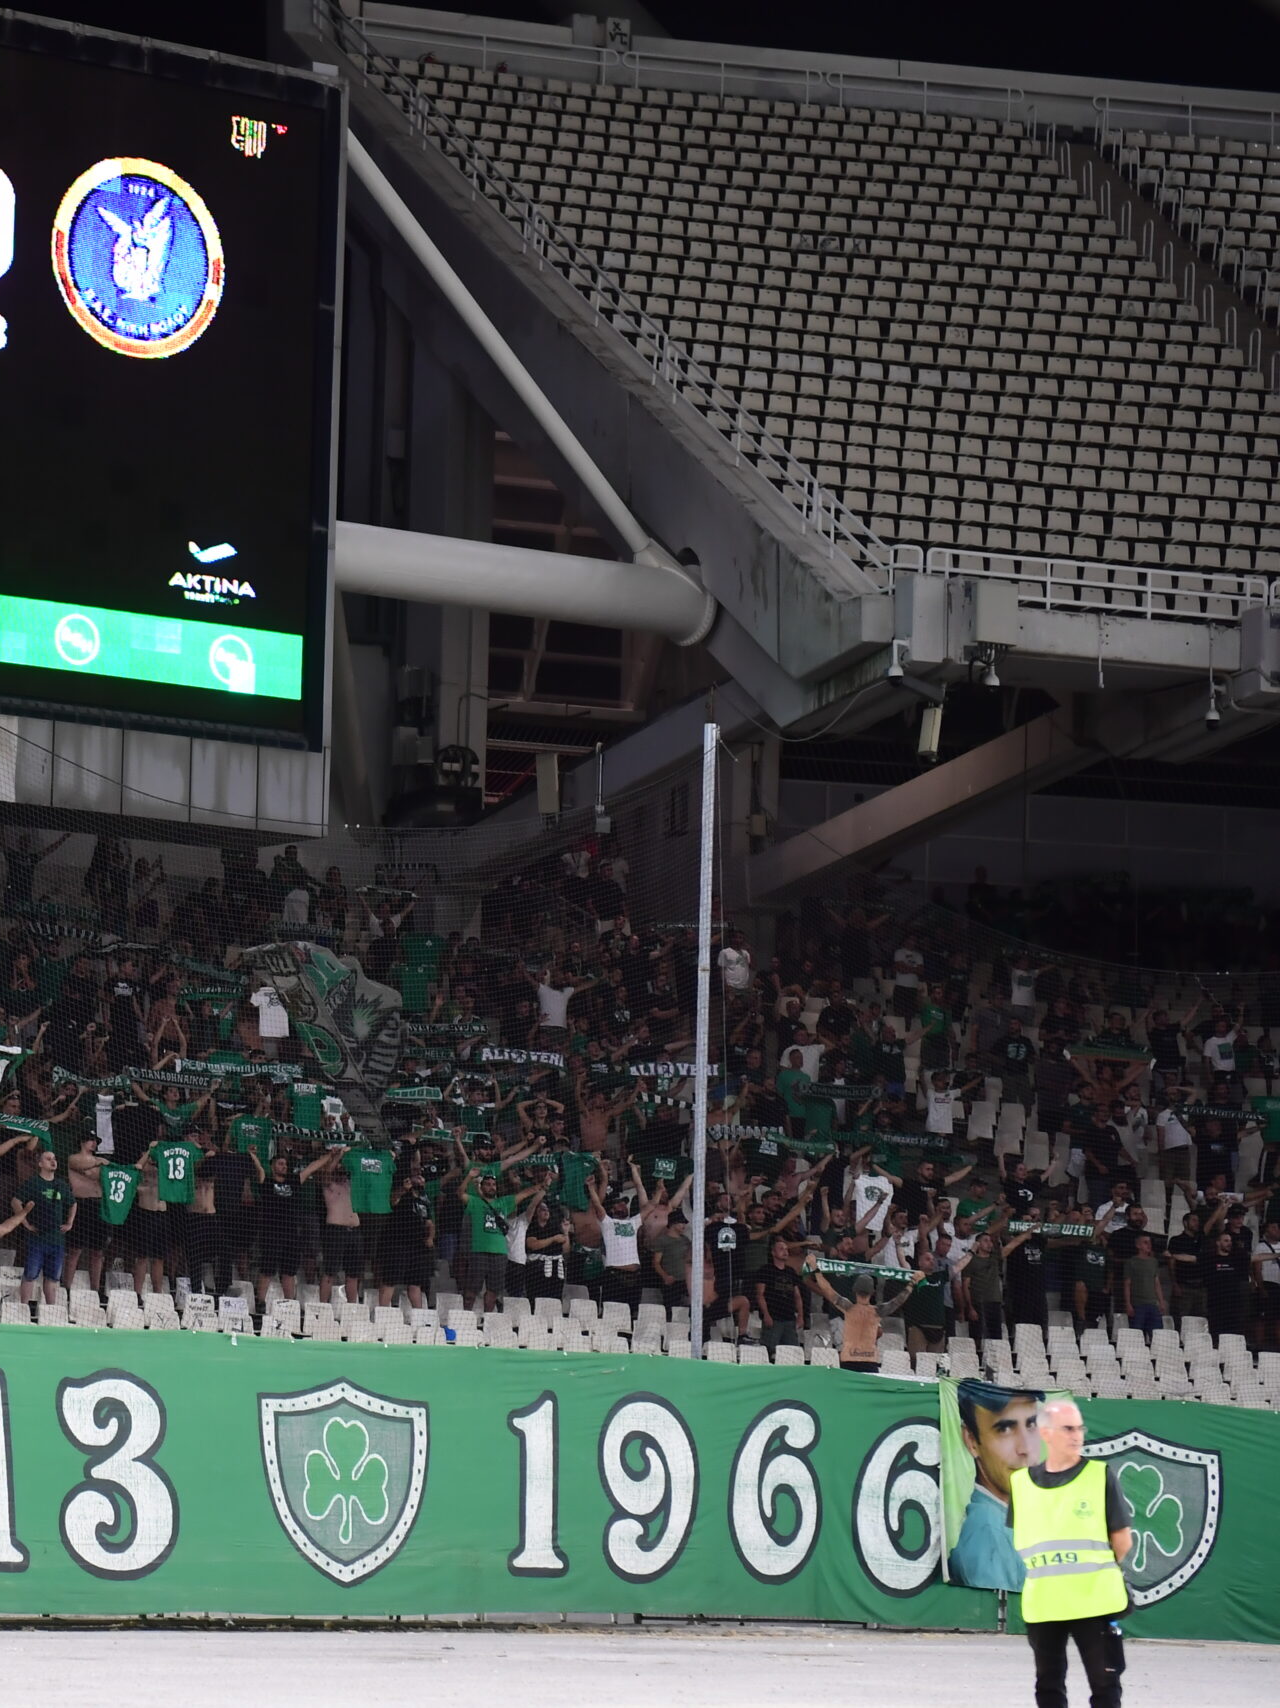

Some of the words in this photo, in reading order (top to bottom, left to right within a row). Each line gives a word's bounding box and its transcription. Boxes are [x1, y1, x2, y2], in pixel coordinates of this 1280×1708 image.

[168, 571, 256, 598] AKTINA
[167, 1157, 185, 1180] 13
[109, 1180, 126, 1203] 13
[506, 1390, 942, 1598] 1966
